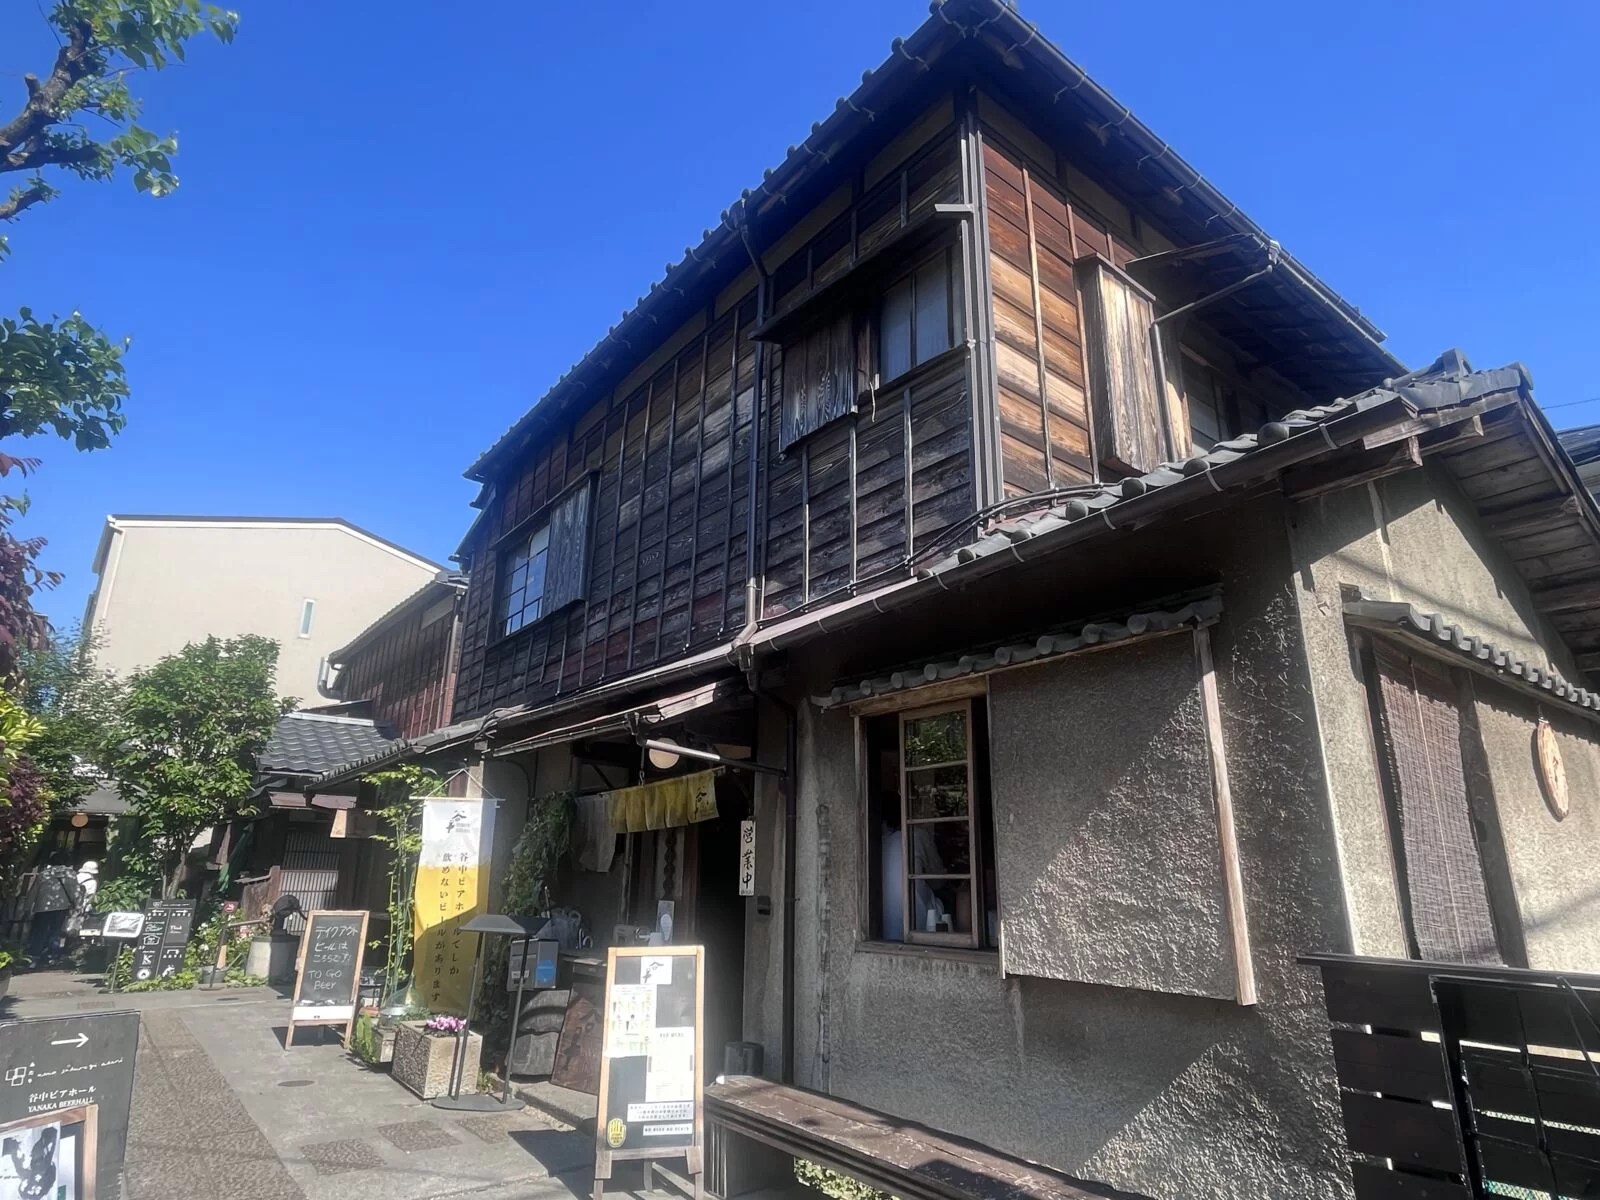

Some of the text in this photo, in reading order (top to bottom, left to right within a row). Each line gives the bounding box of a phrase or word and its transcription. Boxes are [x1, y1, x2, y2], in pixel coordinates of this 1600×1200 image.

[742, 826, 754, 889] 営業中
[308, 969, 342, 979] TO GO
[29, 1085, 97, 1103] 谷中ビアホール
[28, 1096, 95, 1113] YANAKA BEERHALL
